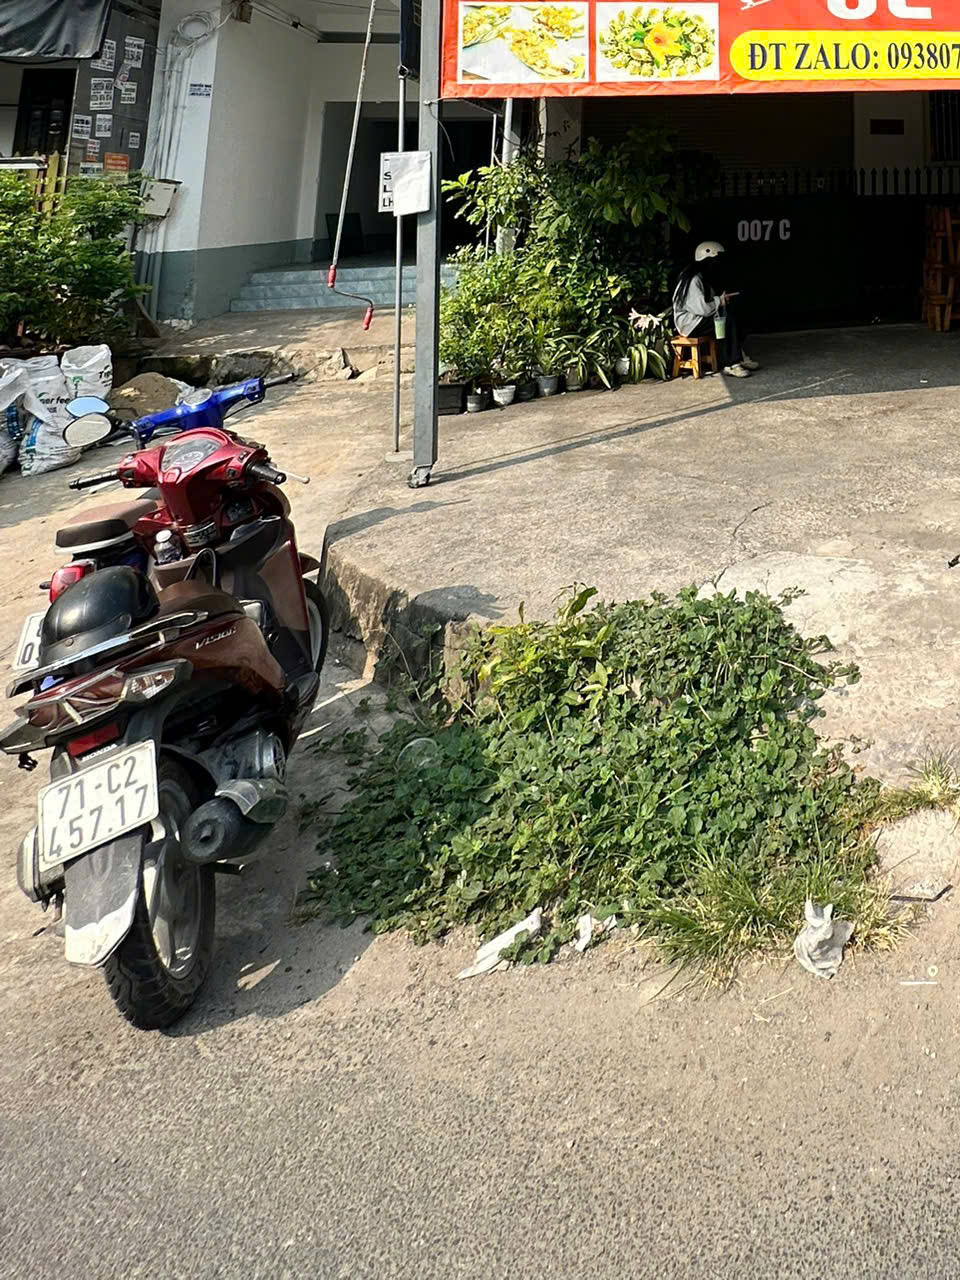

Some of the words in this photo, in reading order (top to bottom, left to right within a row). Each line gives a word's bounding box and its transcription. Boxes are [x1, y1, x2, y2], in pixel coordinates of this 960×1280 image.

[748, 42, 786, 70] ĐT
[795, 42, 879, 70] ZALO:
[737, 219, 774, 241] 007
[779, 218, 791, 240] C
[49, 784, 149, 857] 457.17
